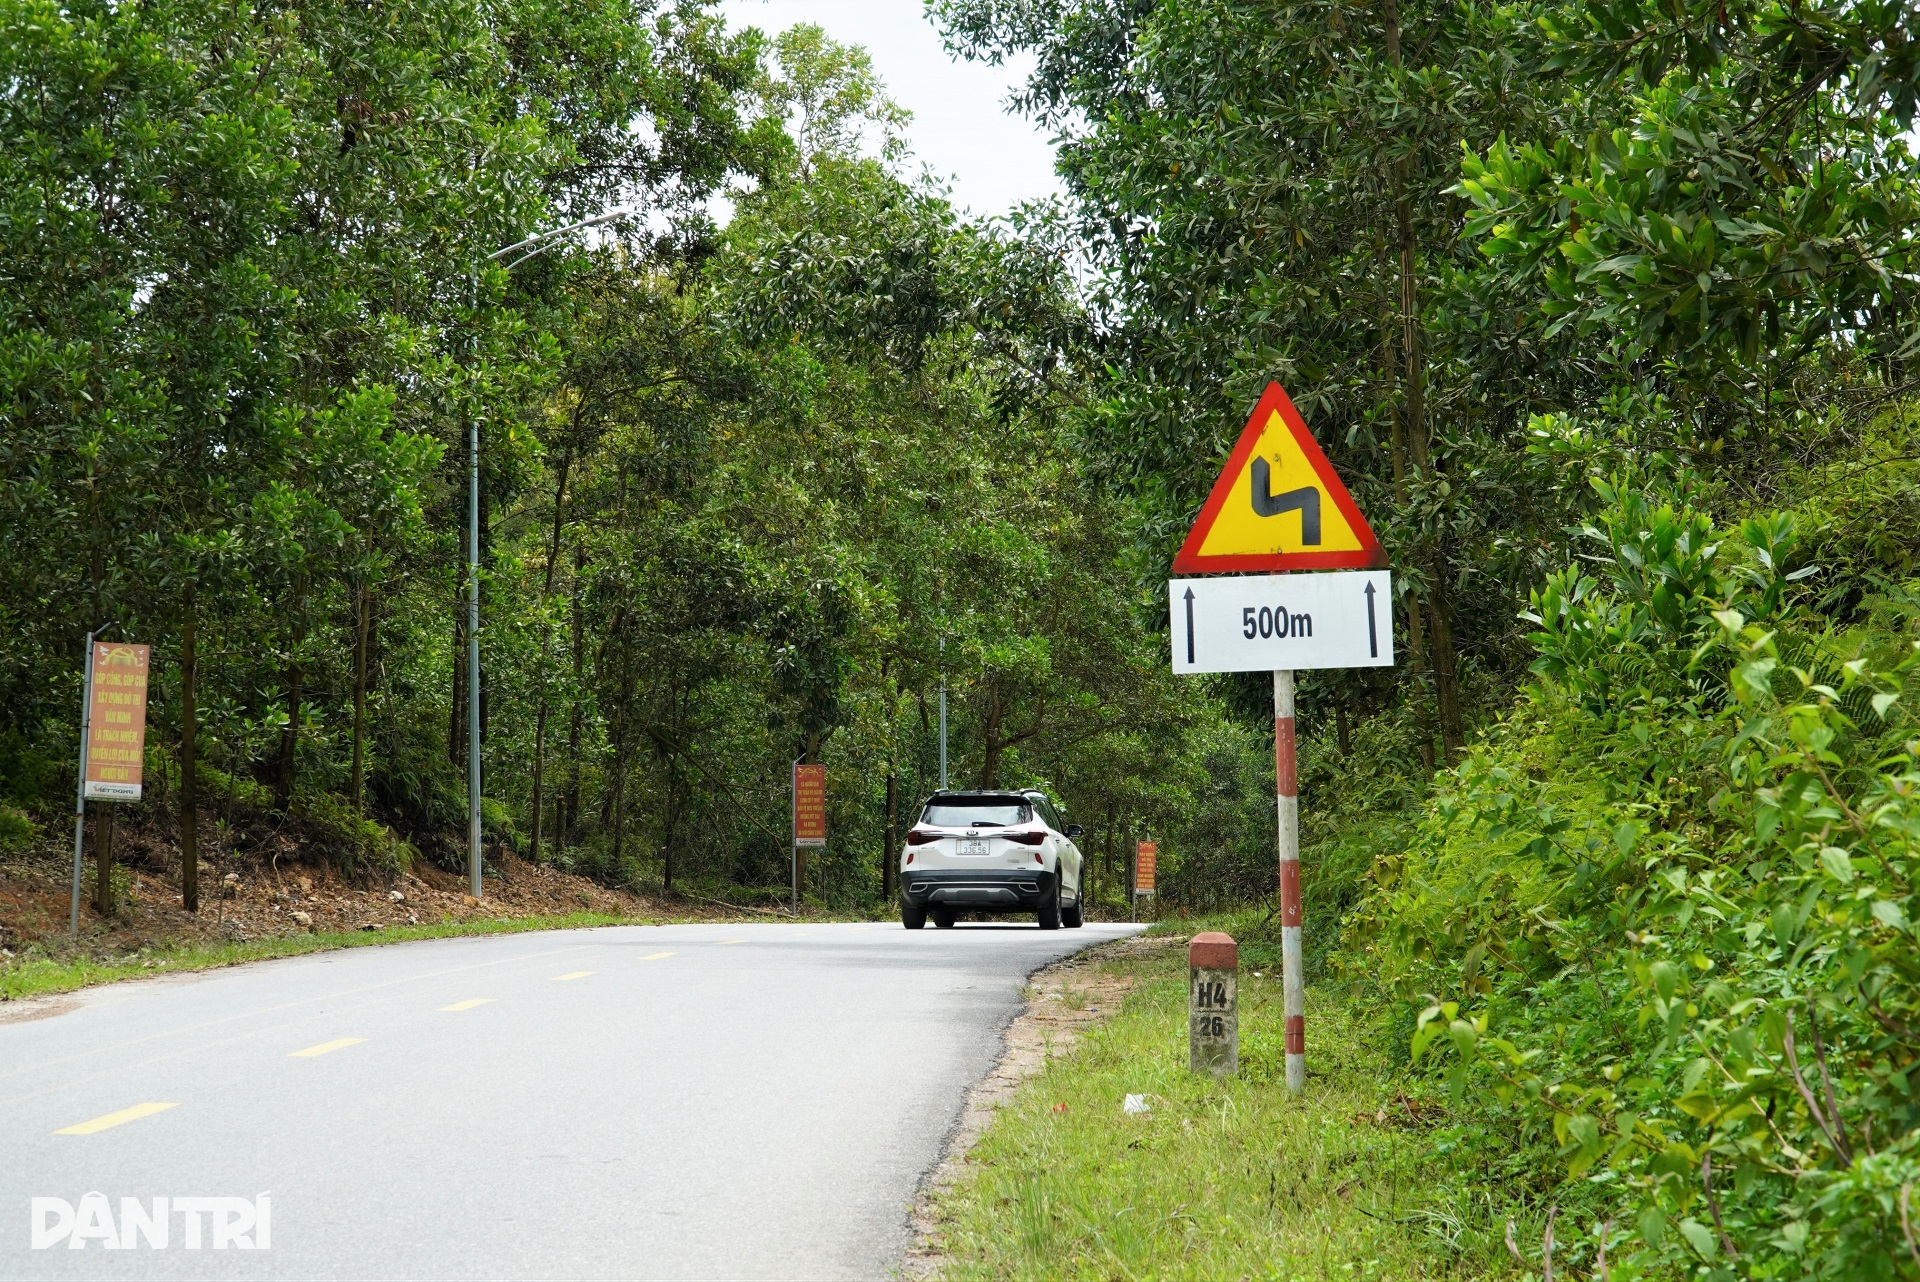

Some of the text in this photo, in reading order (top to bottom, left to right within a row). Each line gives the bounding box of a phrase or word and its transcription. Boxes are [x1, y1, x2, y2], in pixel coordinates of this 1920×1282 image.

[1243, 605, 1312, 640] 500m
[1198, 982, 1227, 1008] H4
[1200, 1016, 1223, 1037] 26
